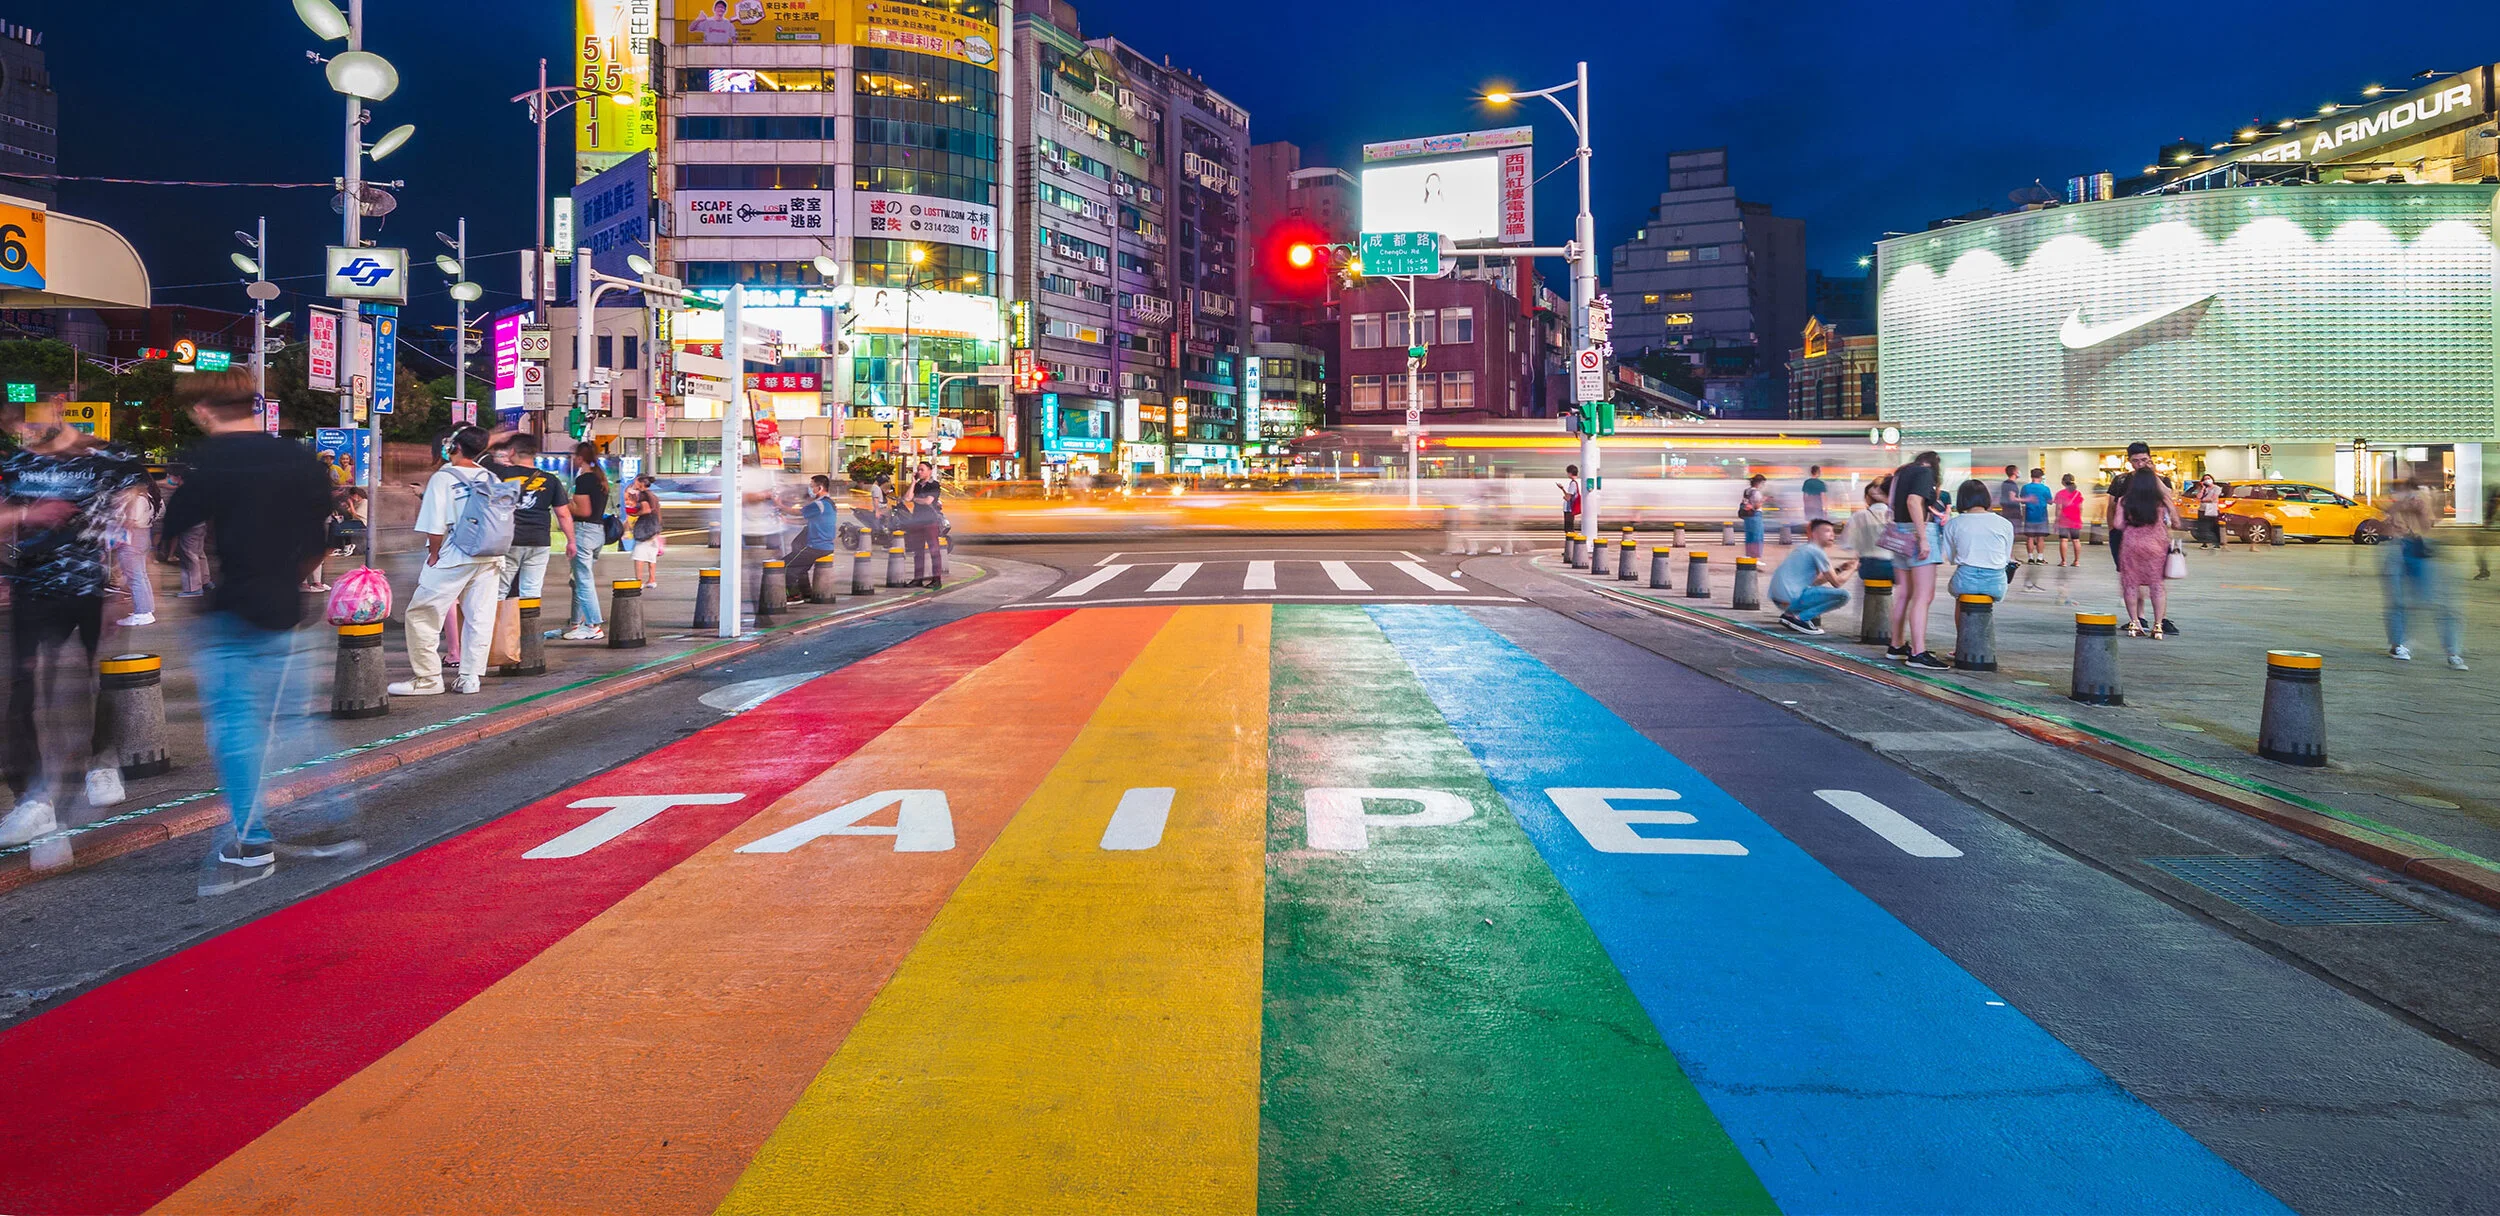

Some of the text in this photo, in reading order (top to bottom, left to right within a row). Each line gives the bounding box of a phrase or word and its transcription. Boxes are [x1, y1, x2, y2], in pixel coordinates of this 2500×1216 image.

[774, 12, 819, 21] 工作生活吧
[922, 10, 948, 22] 不二家
[2310, 83, 2472, 155] ARMOUR
[1505, 153, 1525, 236] 西門紅樓電視牆
[691, 201, 733, 211] ESCAPE
[790, 197, 822, 212] 密室
[870, 199, 902, 215] 迷の
[700, 213, 733, 224] GAME
[923, 207, 965, 220] LOSTTW.COM
[790, 214, 822, 228] 逃脫
[923, 221, 960, 234] 2314 2383
[970, 226, 989, 242] 6/F
[1369, 233, 1430, 247] 成都路
[0, 224, 27, 271] 6
[522, 785, 1963, 861] TAIPEI
